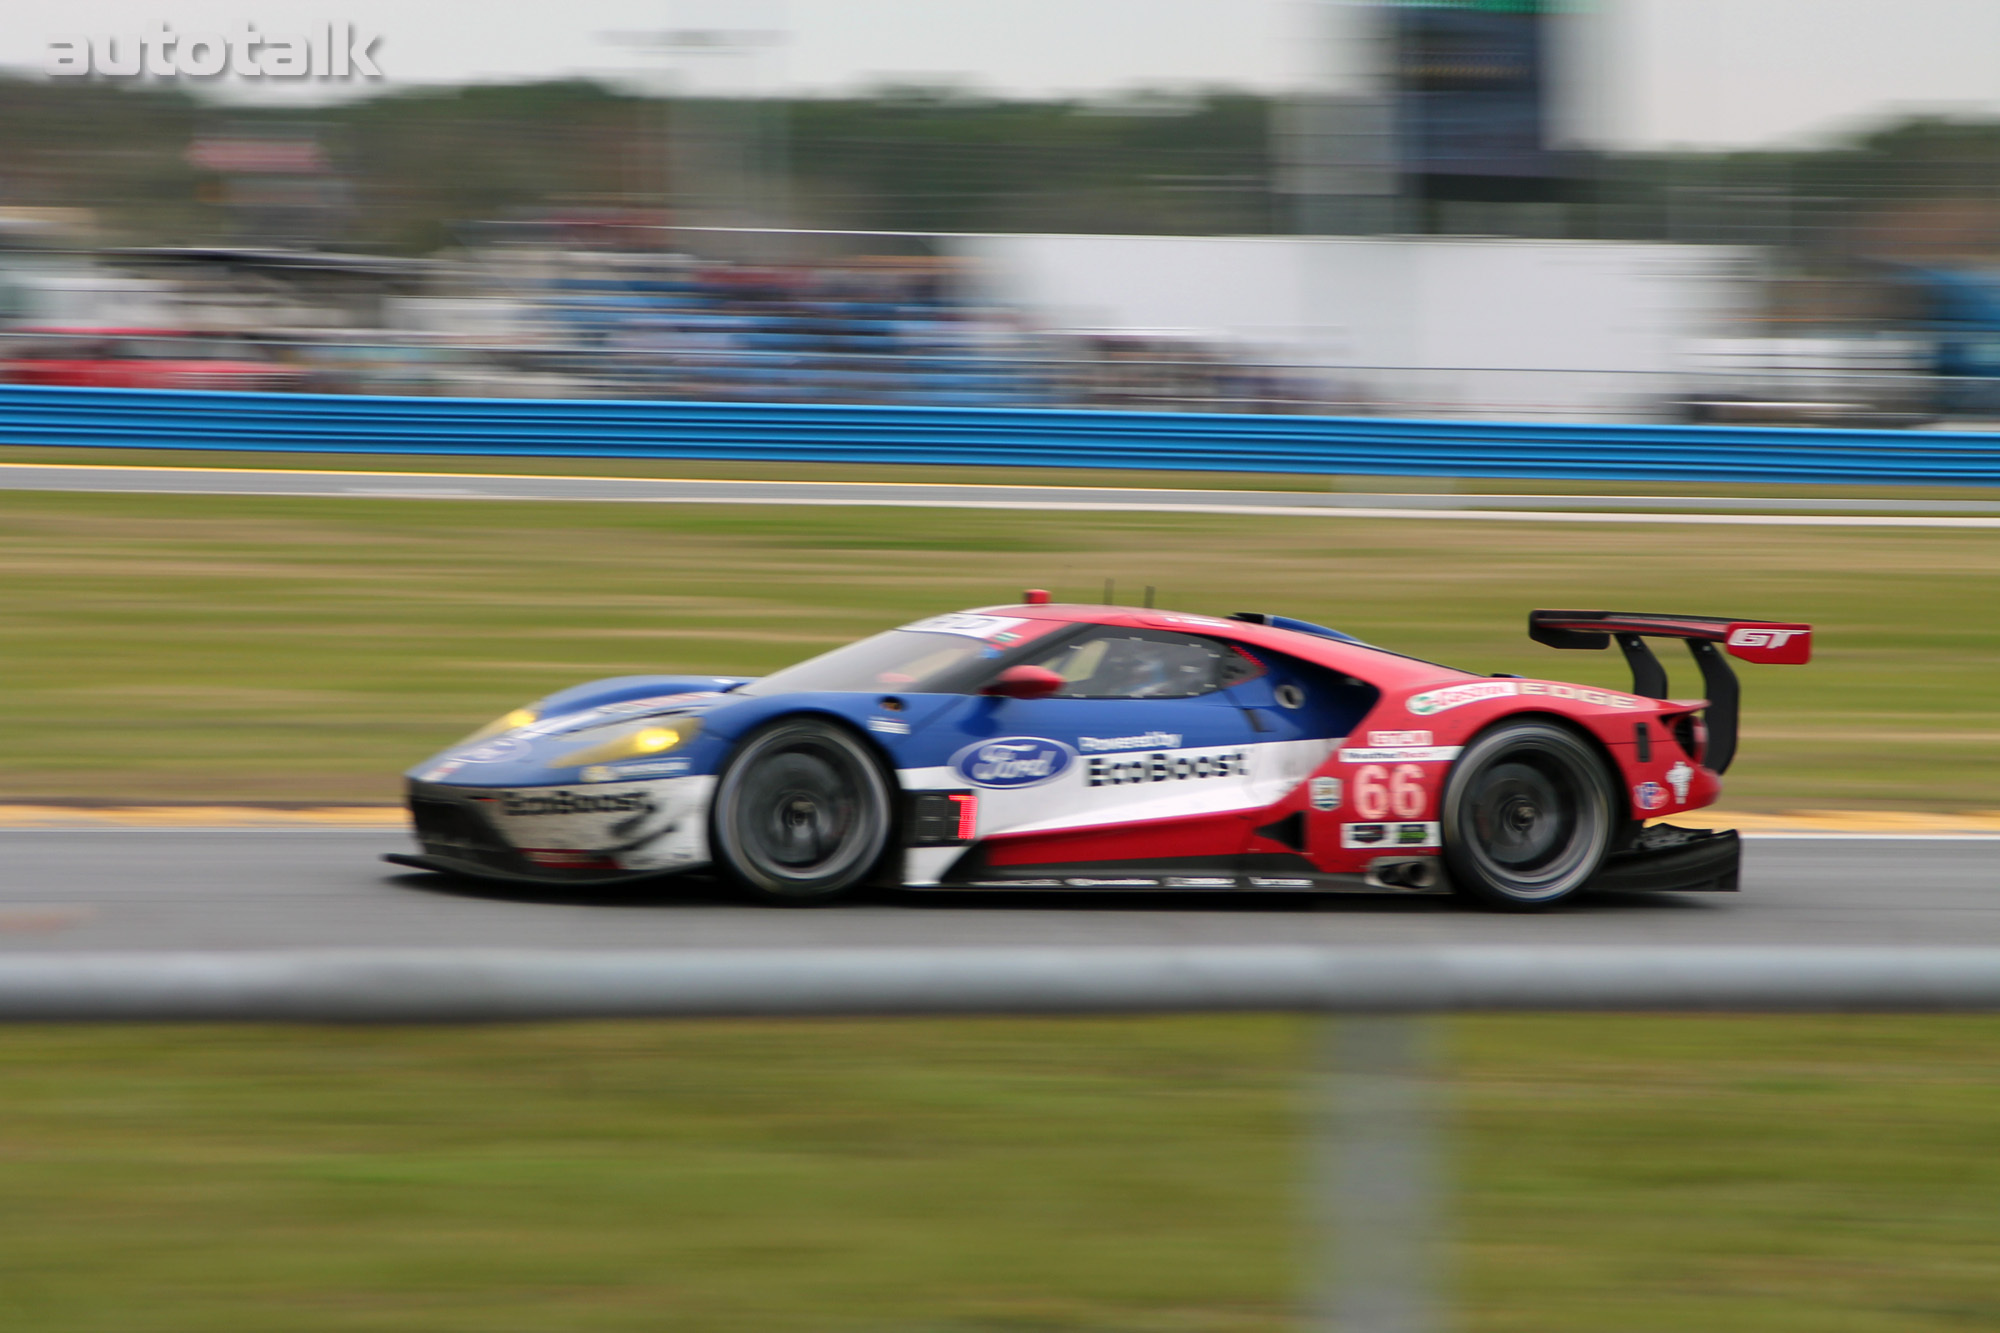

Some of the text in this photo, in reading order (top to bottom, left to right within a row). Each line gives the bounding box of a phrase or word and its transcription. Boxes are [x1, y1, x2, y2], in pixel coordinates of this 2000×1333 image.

[1728, 628, 1811, 649] GT
[1517, 682, 1640, 709] EDGE
[972, 744, 1056, 780] Ford
[1086, 753, 1249, 787] EcoBoost
[1353, 764, 1428, 820] 66
